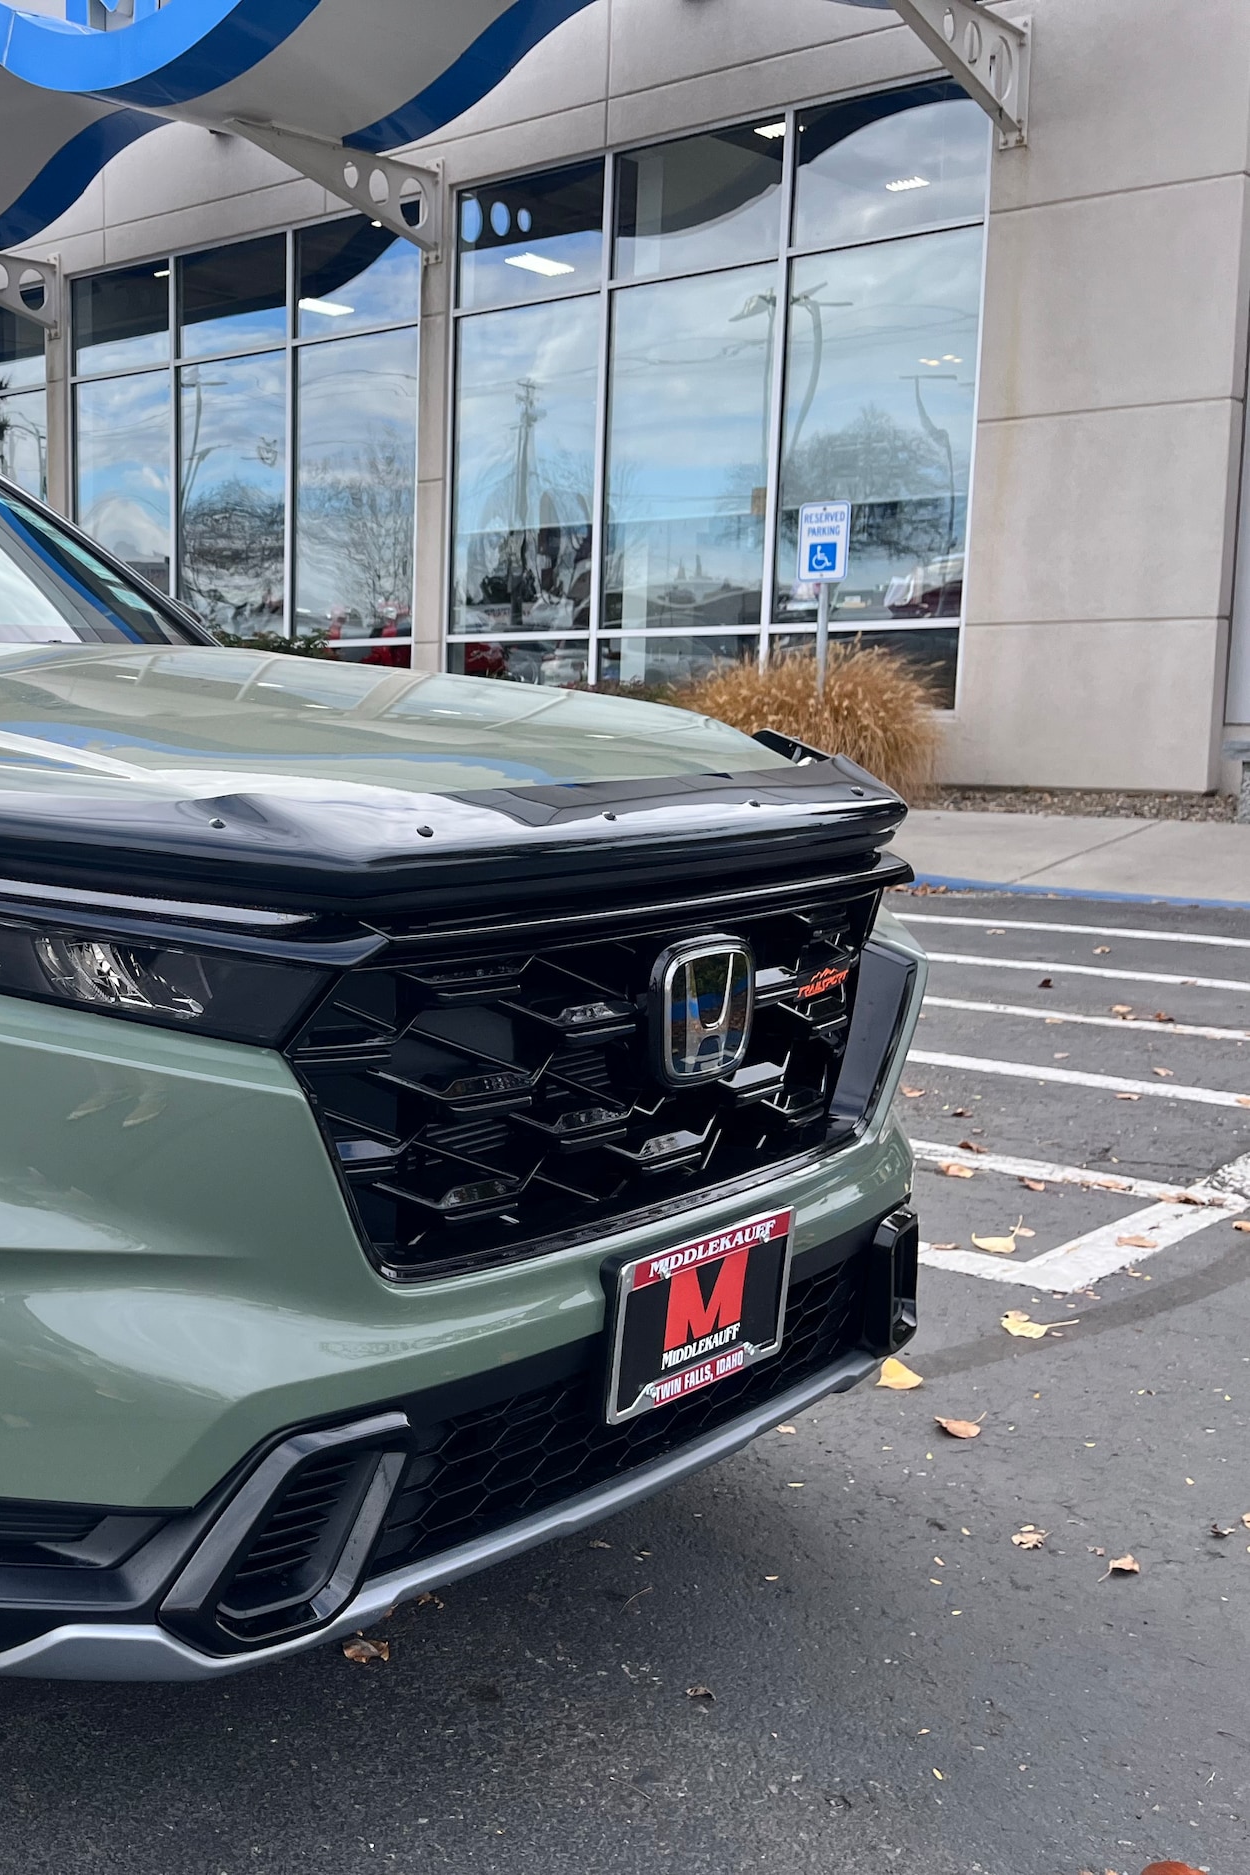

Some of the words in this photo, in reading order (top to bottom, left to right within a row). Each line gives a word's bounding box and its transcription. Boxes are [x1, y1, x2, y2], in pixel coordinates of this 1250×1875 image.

[804, 510, 846, 524] RESERVED
[807, 524, 841, 537] PARKING
[648, 1219, 776, 1278] MIDDLEKAUFF
[663, 1247, 750, 1352] M
[661, 1322, 741, 1371] MIDDLEKAUFF
[655, 1378, 682, 1402] TWIN
[684, 1362, 714, 1388] FALLS,
[716, 1350, 744, 1376] IDAHO
